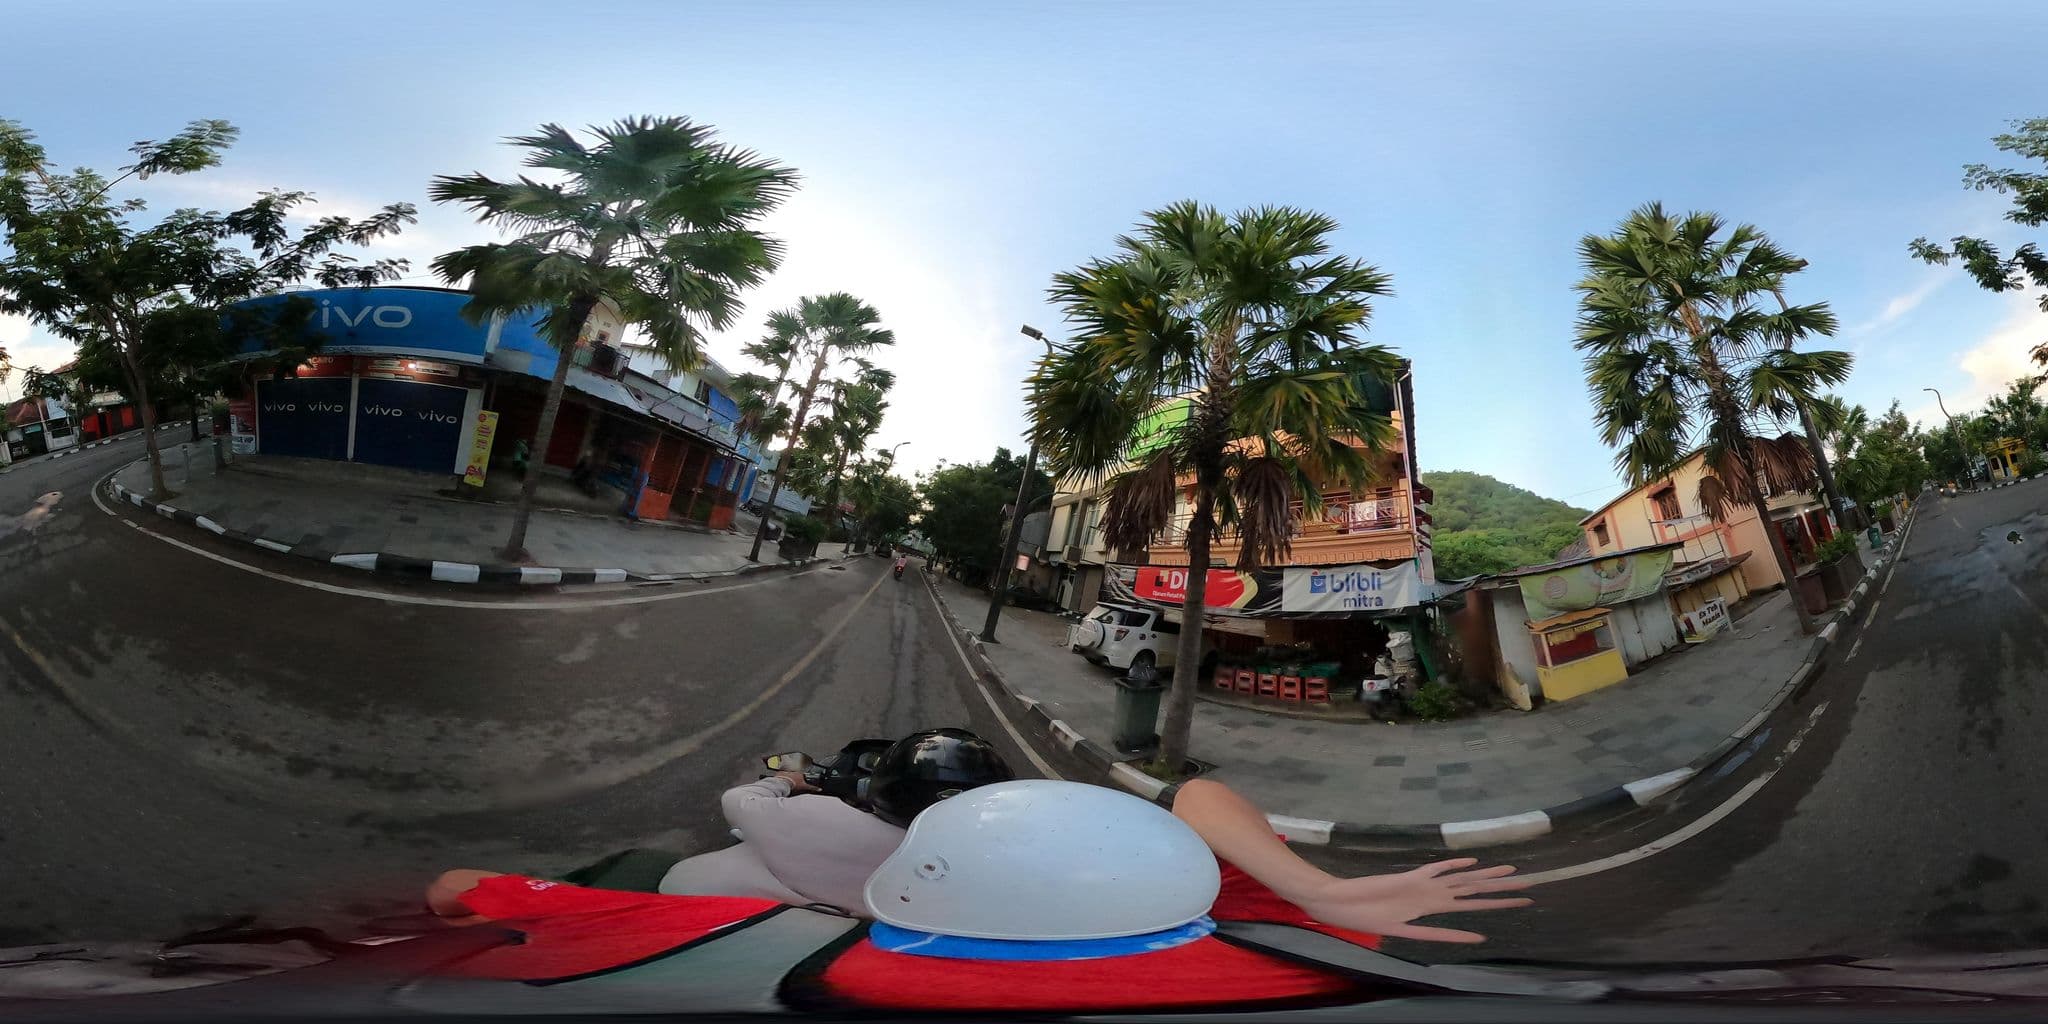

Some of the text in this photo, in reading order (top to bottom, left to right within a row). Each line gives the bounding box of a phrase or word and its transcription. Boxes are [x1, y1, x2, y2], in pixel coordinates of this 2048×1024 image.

[264, 402, 296, 412] vivo
[308, 401, 344, 413] vivo
[364, 404, 403, 417] vivo
[418, 409, 457, 424] vivo
[1330, 572, 1381, 593] blibli
[1343, 593, 1383, 608] mitra
[1706, 603, 1718, 614] Teh
